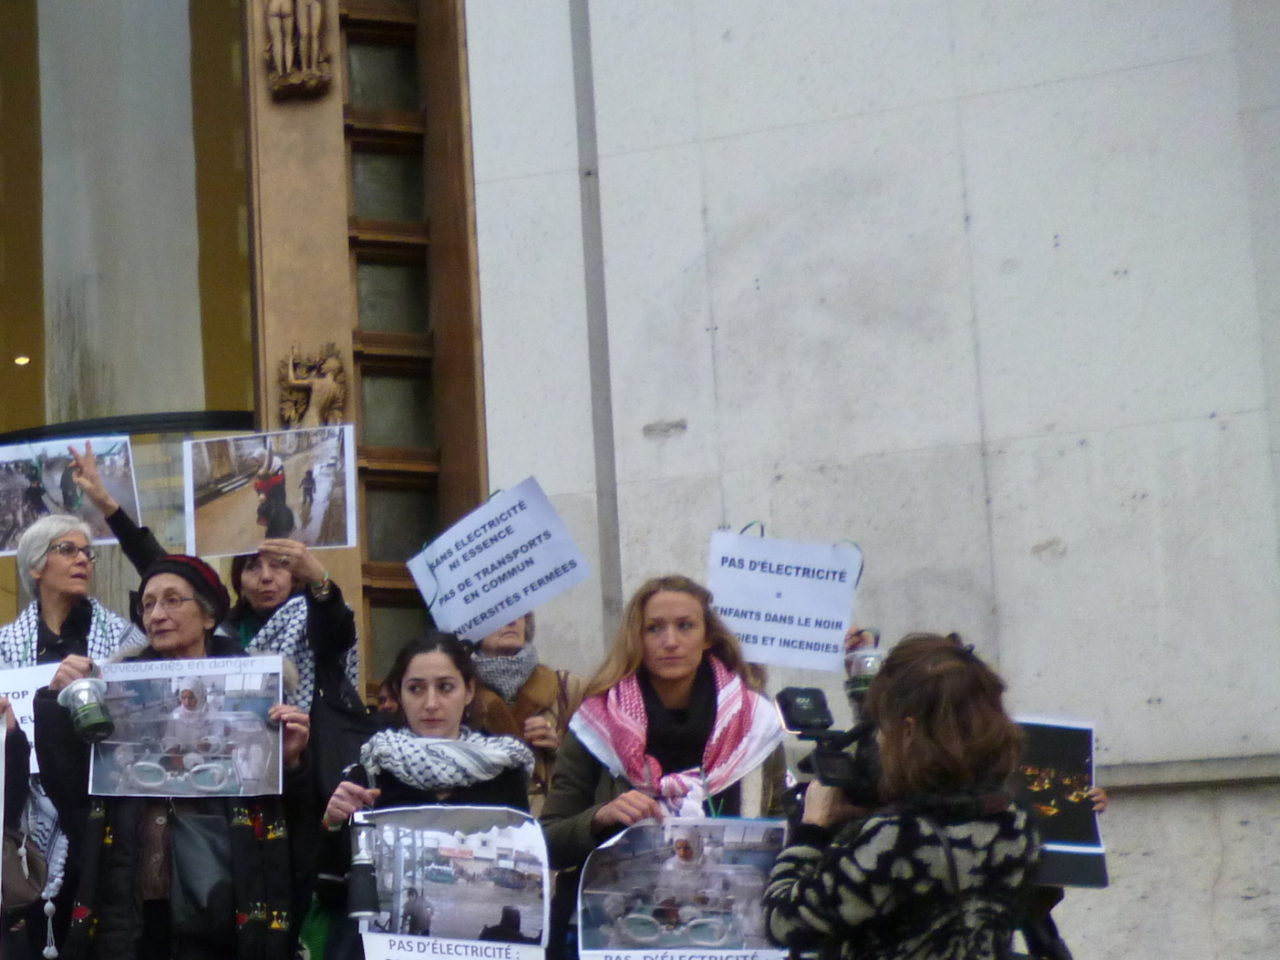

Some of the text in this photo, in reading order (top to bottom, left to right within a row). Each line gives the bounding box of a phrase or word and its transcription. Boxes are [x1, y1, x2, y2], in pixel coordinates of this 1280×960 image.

[429, 499, 528, 573] SANS ÉLECTRICITÉ
[448, 524, 515, 573] NI ESSENCE
[438, 530, 552, 608] PAS DE TRANSPORTS
[463, 556, 535, 606] EN COMMUN
[721, 556, 847, 582] PAS D'ÉLECTRICITÉ
[453, 558, 578, 638] NIVERSITÉS FERMÉES
[764, 612, 795, 626] DANS
[797, 617, 812, 628] LE
[814, 619, 843, 631] NOIR
[762, 636, 777, 646] ET
[779, 638, 840, 654] INCENDIES
[389, 939, 414, 952] PAS
[417, 940, 512, 960] D'ÉLECTRICITÉ
